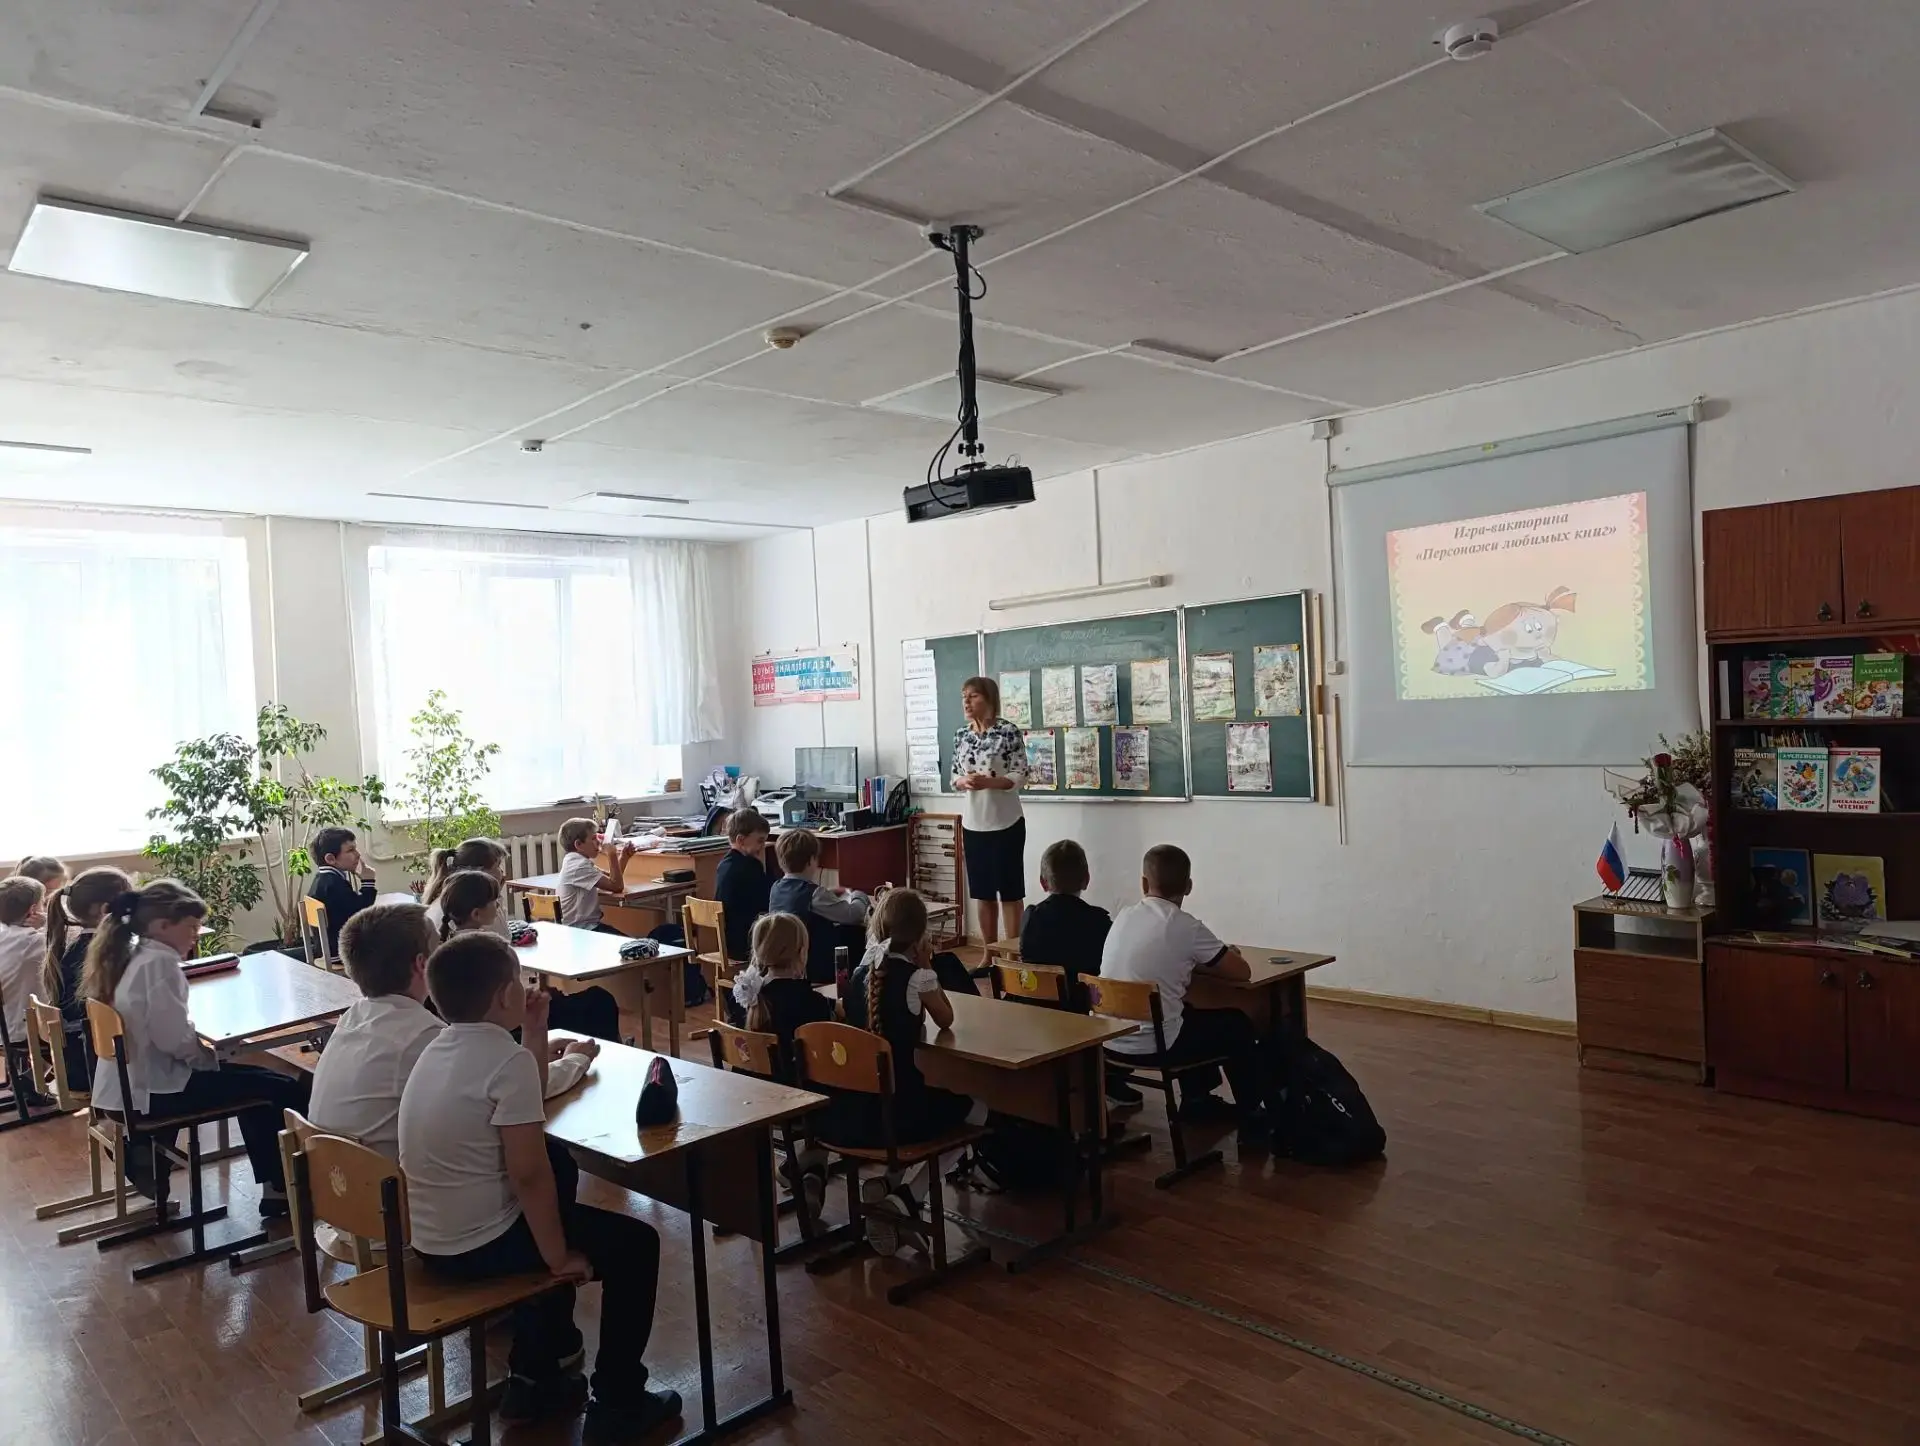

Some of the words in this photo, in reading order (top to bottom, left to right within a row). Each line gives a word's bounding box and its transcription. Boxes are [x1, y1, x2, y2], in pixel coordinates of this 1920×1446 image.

[1454, 513, 1568, 539] Игра-викторина
[1416, 542, 1498, 560] «Персонажи
[1502, 532, 1570, 549] любимых
[1575, 526, 1617, 539] книг»
